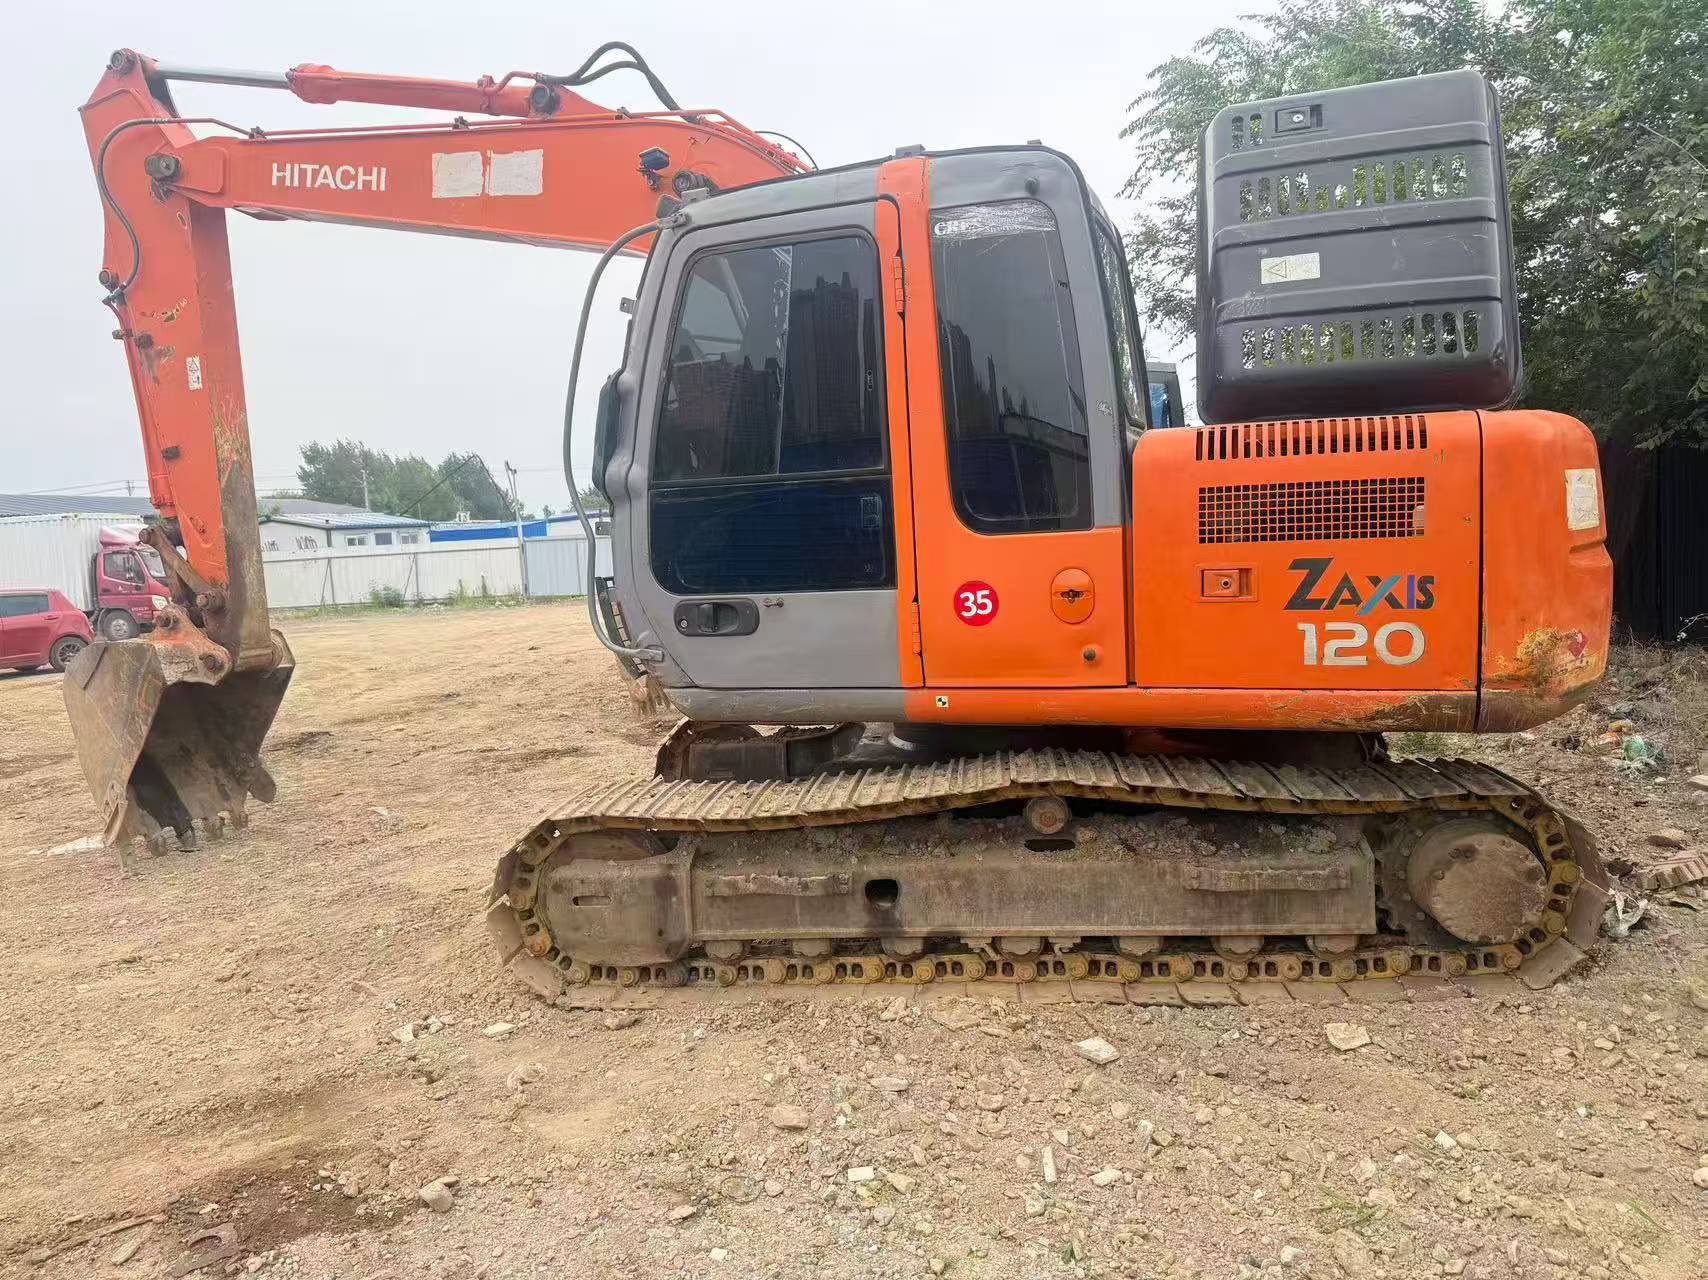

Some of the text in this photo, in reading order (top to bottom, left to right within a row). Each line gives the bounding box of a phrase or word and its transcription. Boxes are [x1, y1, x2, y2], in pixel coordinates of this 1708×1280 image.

[271, 163, 387, 192] HITACHI
[959, 590, 993, 617] 35
[1297, 622, 1426, 666] 120
